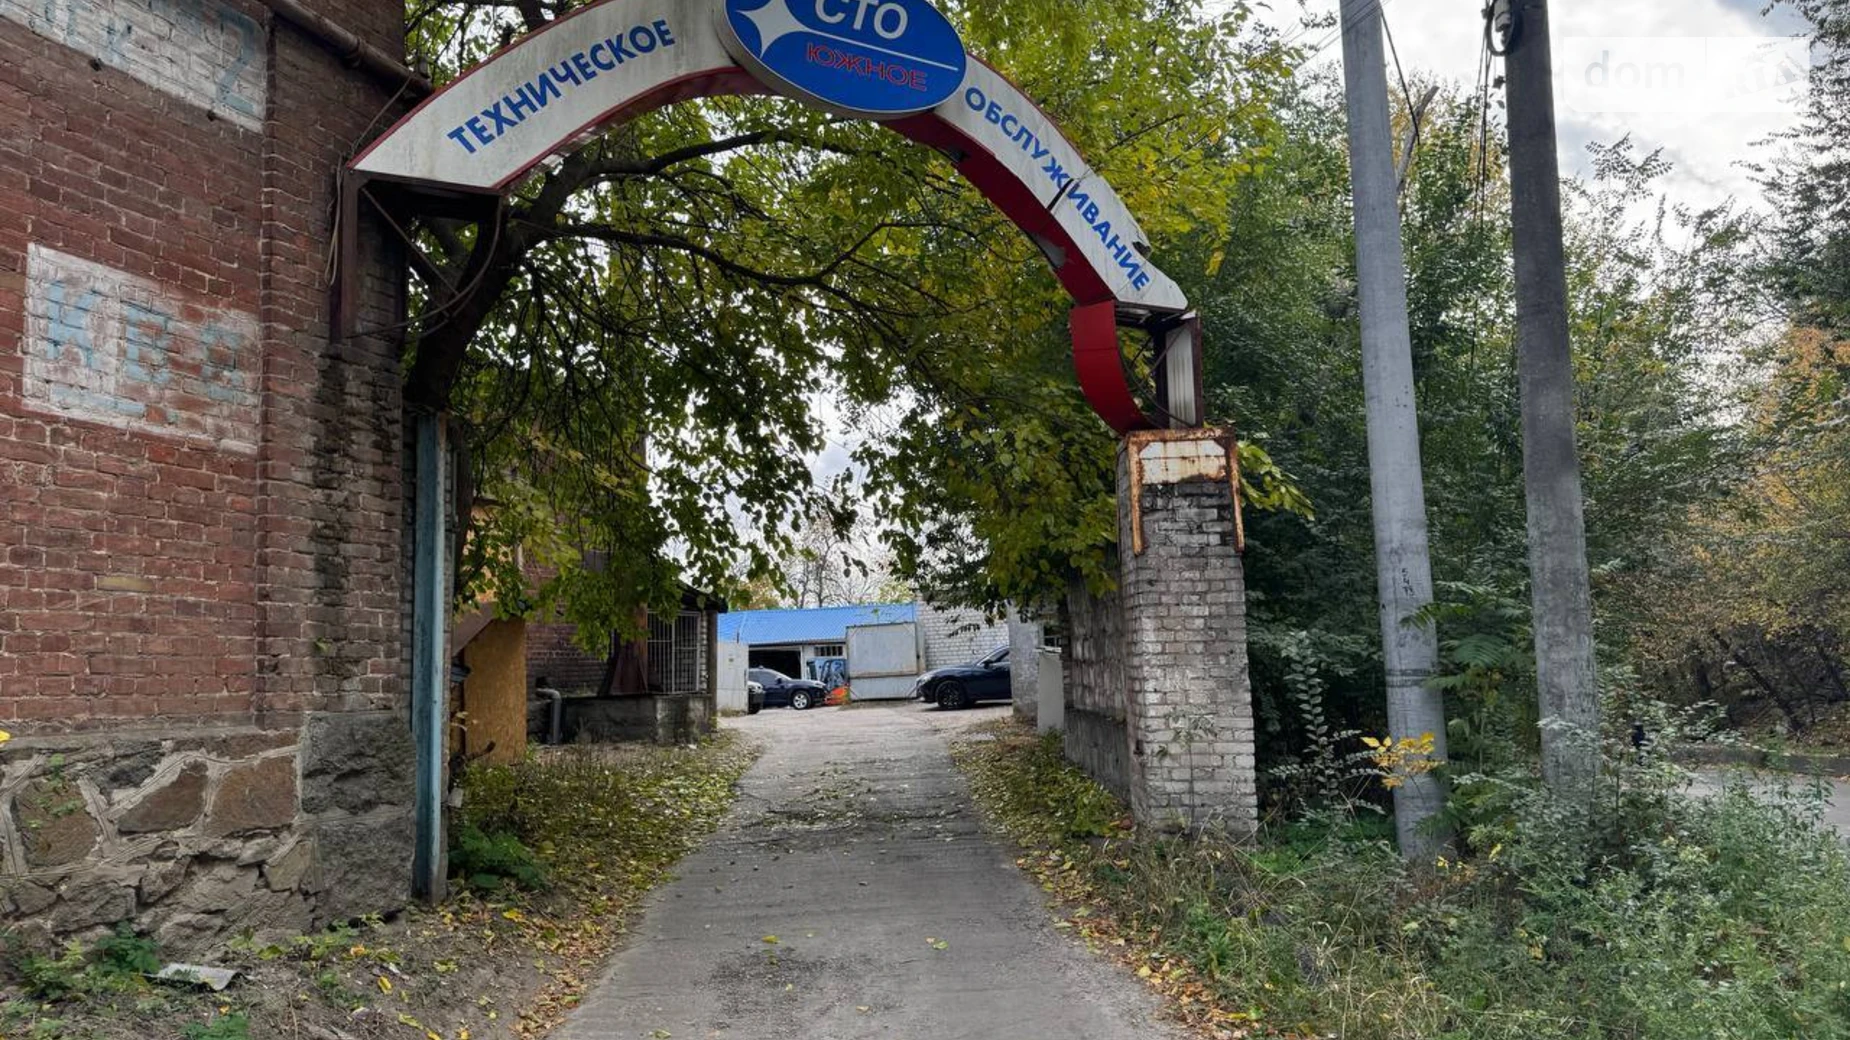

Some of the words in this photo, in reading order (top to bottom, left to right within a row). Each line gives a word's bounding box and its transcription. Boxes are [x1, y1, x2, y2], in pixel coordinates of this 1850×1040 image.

[815, 0, 909, 39] СТО
[806, 42, 928, 92] ЮЖНОЕ
[447, 19, 675, 153] ТЕХНИЧЕСКОЕ
[964, 87, 1150, 291] ОБСЛУЖИВАНИЕ
